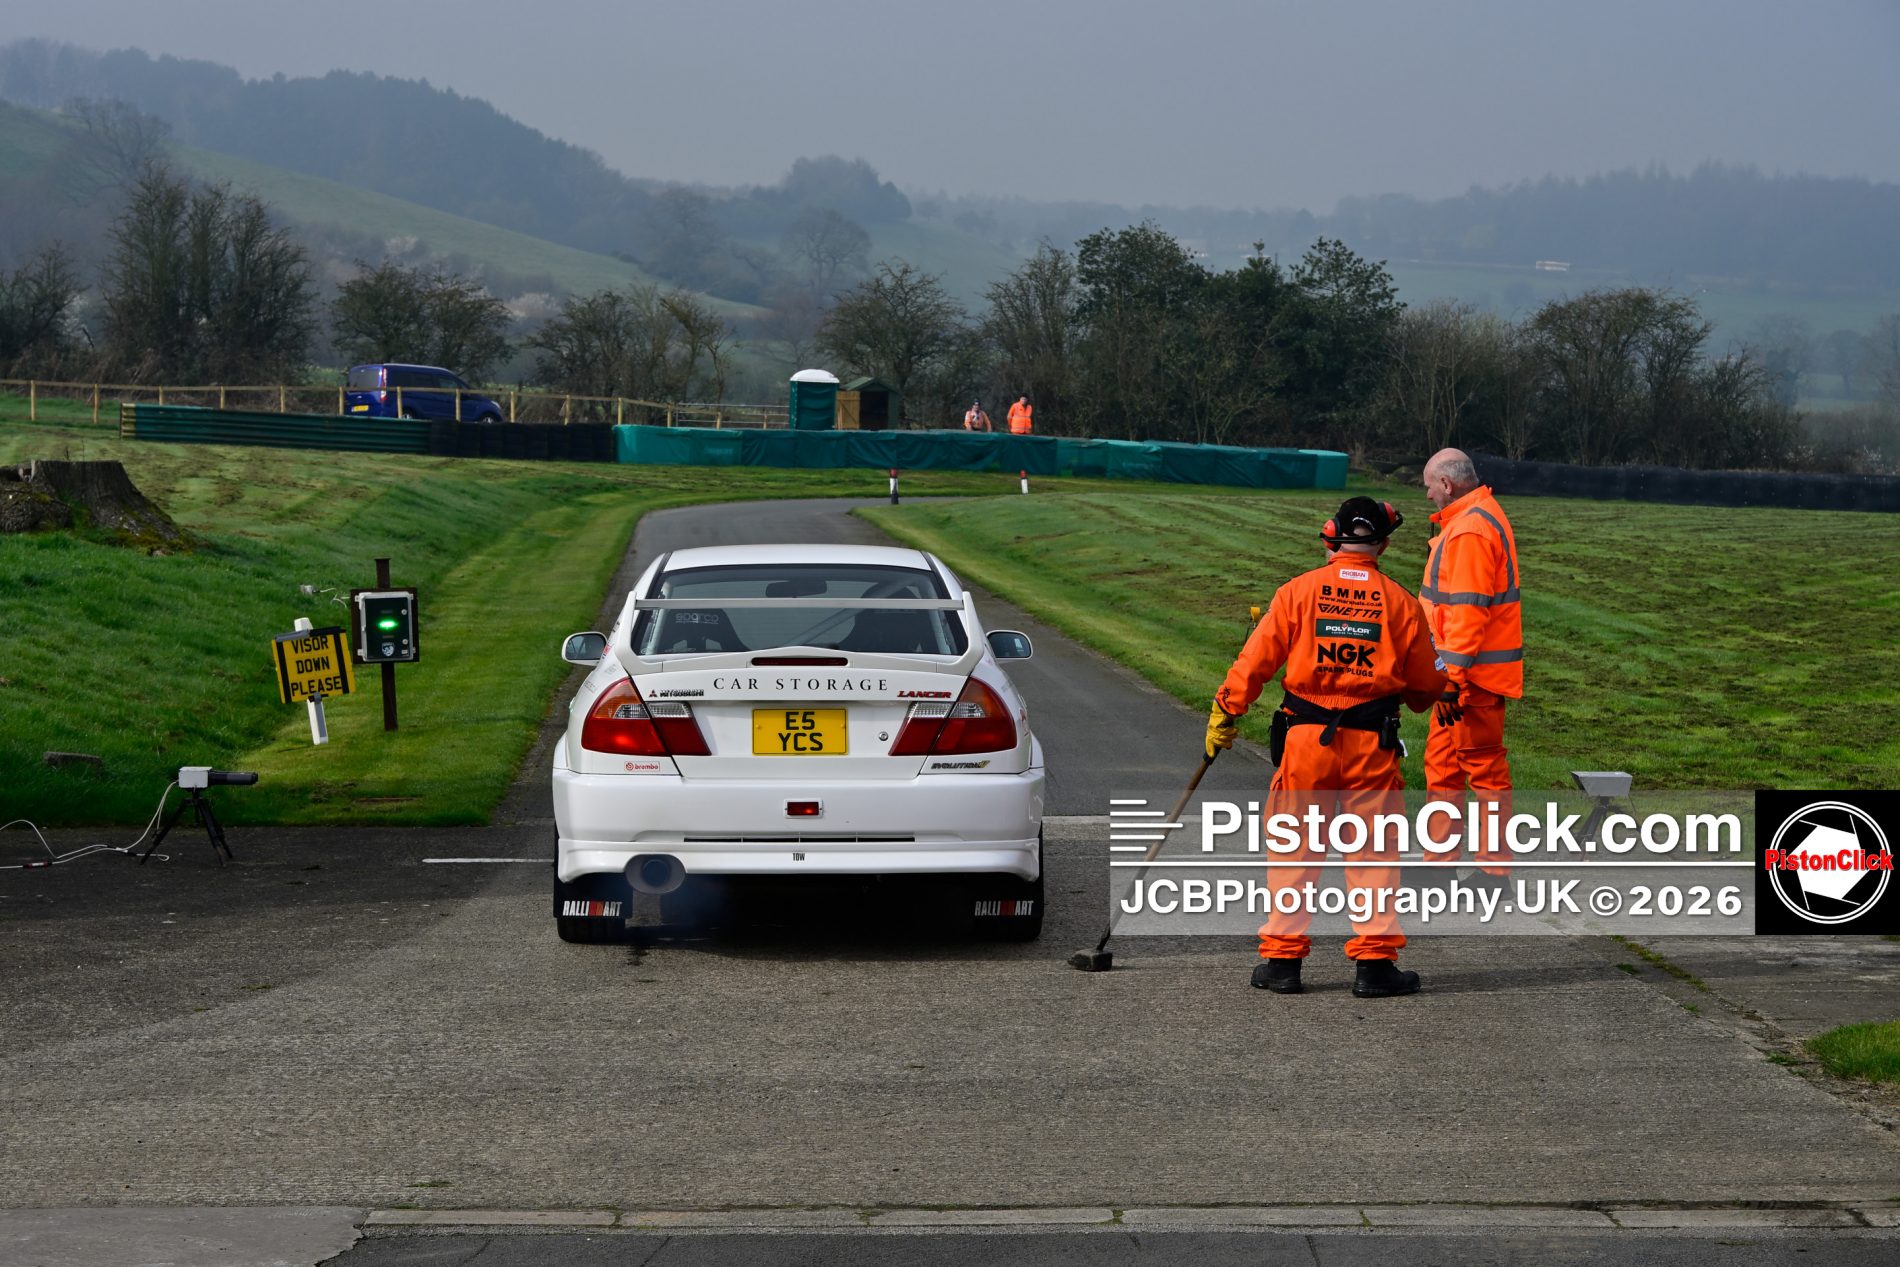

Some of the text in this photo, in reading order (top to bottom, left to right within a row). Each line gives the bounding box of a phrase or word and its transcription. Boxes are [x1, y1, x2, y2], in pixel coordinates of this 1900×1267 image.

[1318, 603, 1382, 619] GINETTA
[1325, 625, 1370, 635] POLYFLOR
[291, 636, 329, 654] VISOR
[1317, 642, 1376, 669] NGK
[296, 656, 330, 674] DOWN
[1316, 665, 1374, 678] SPARK PLUGS
[291, 676, 342, 697] PLEASE
[713, 678, 888, 690] CAR STORAGE
[660, 689, 704, 698] MITSUBISHI
[897, 690, 952, 699] LANCER
[785, 711, 815, 731] E5
[778, 732, 823, 752] YCS
[792, 852, 806, 861] TOW
